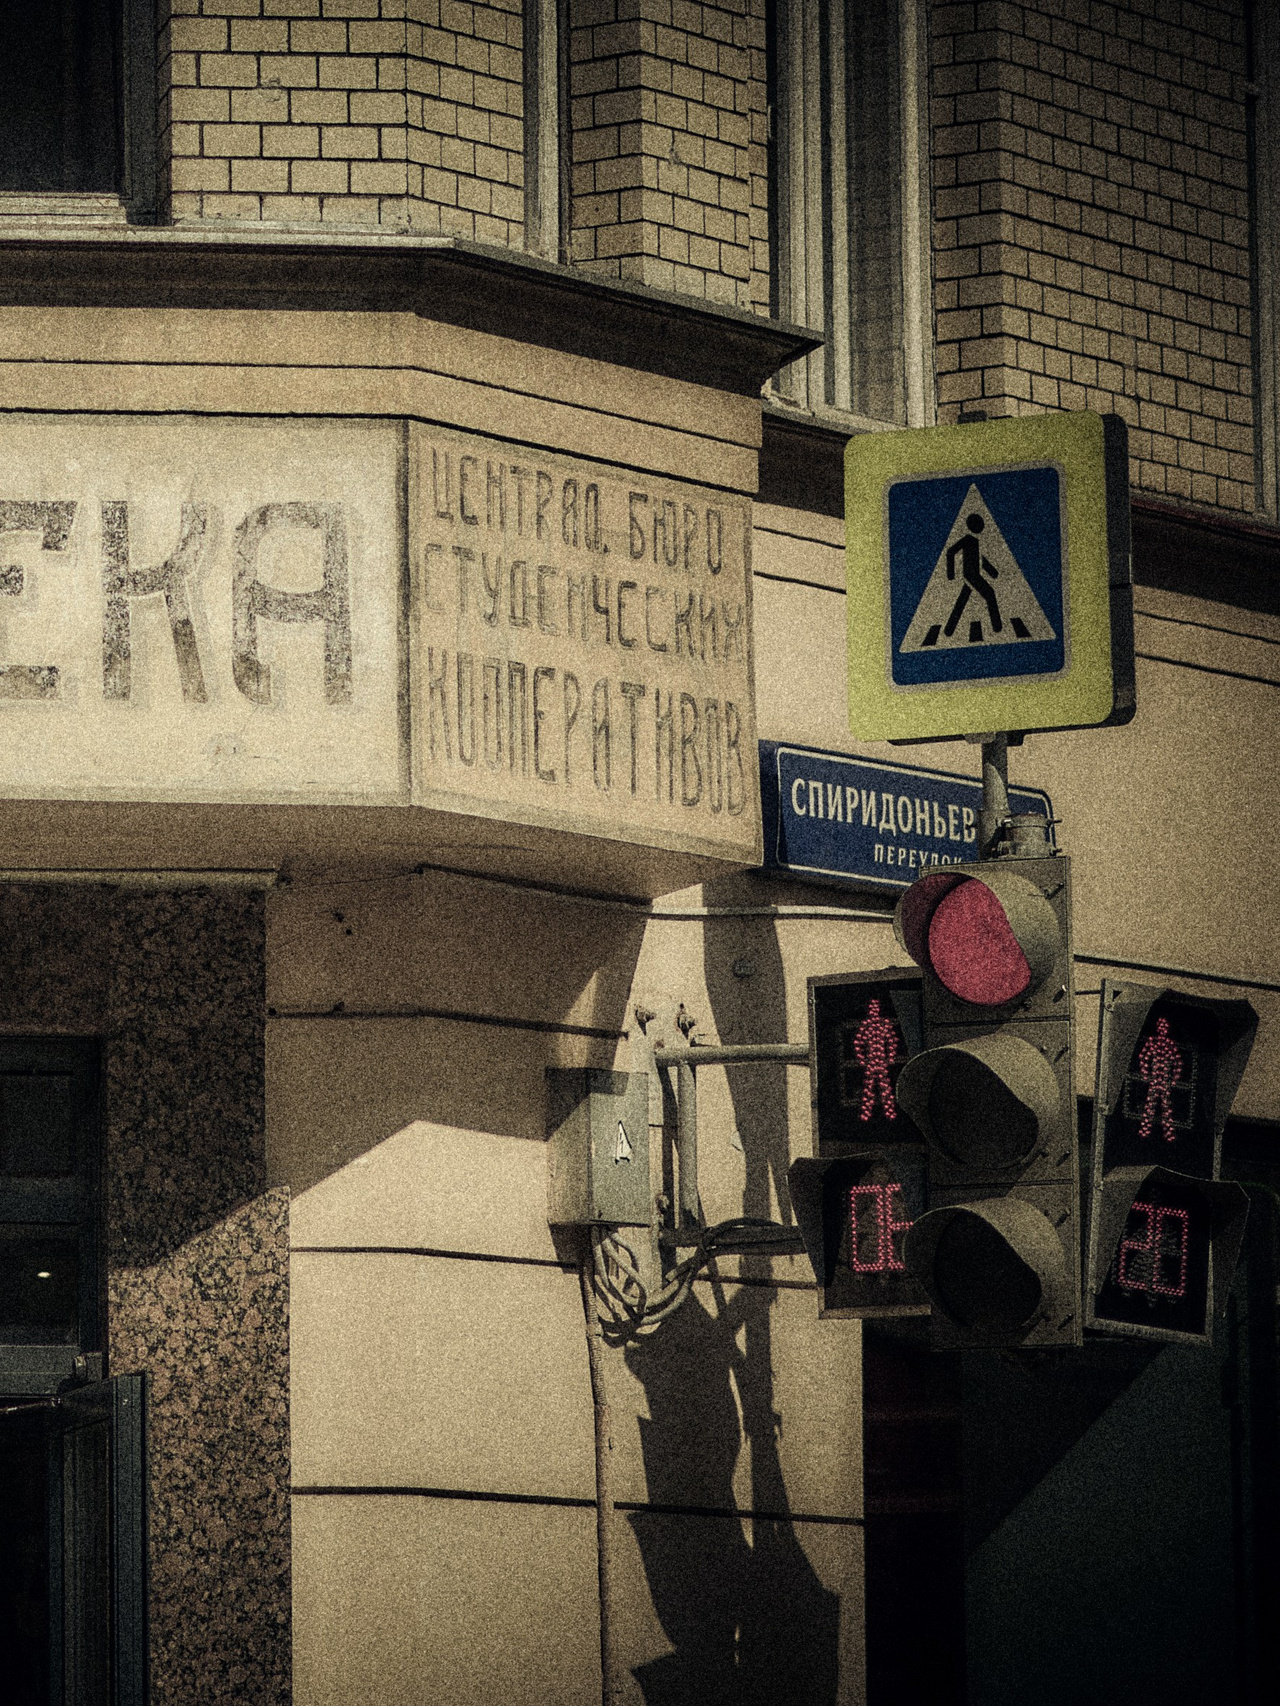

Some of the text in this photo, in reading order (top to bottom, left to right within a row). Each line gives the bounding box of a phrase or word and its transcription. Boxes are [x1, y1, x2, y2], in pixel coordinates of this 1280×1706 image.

[628, 491, 722, 576] БЮРО
[427, 647, 746, 817] КООПЕРАТИВОВ
[791, 778, 976, 843] СПИРИДОНЬЕВ
[1117, 1200, 1190, 1296] 20
